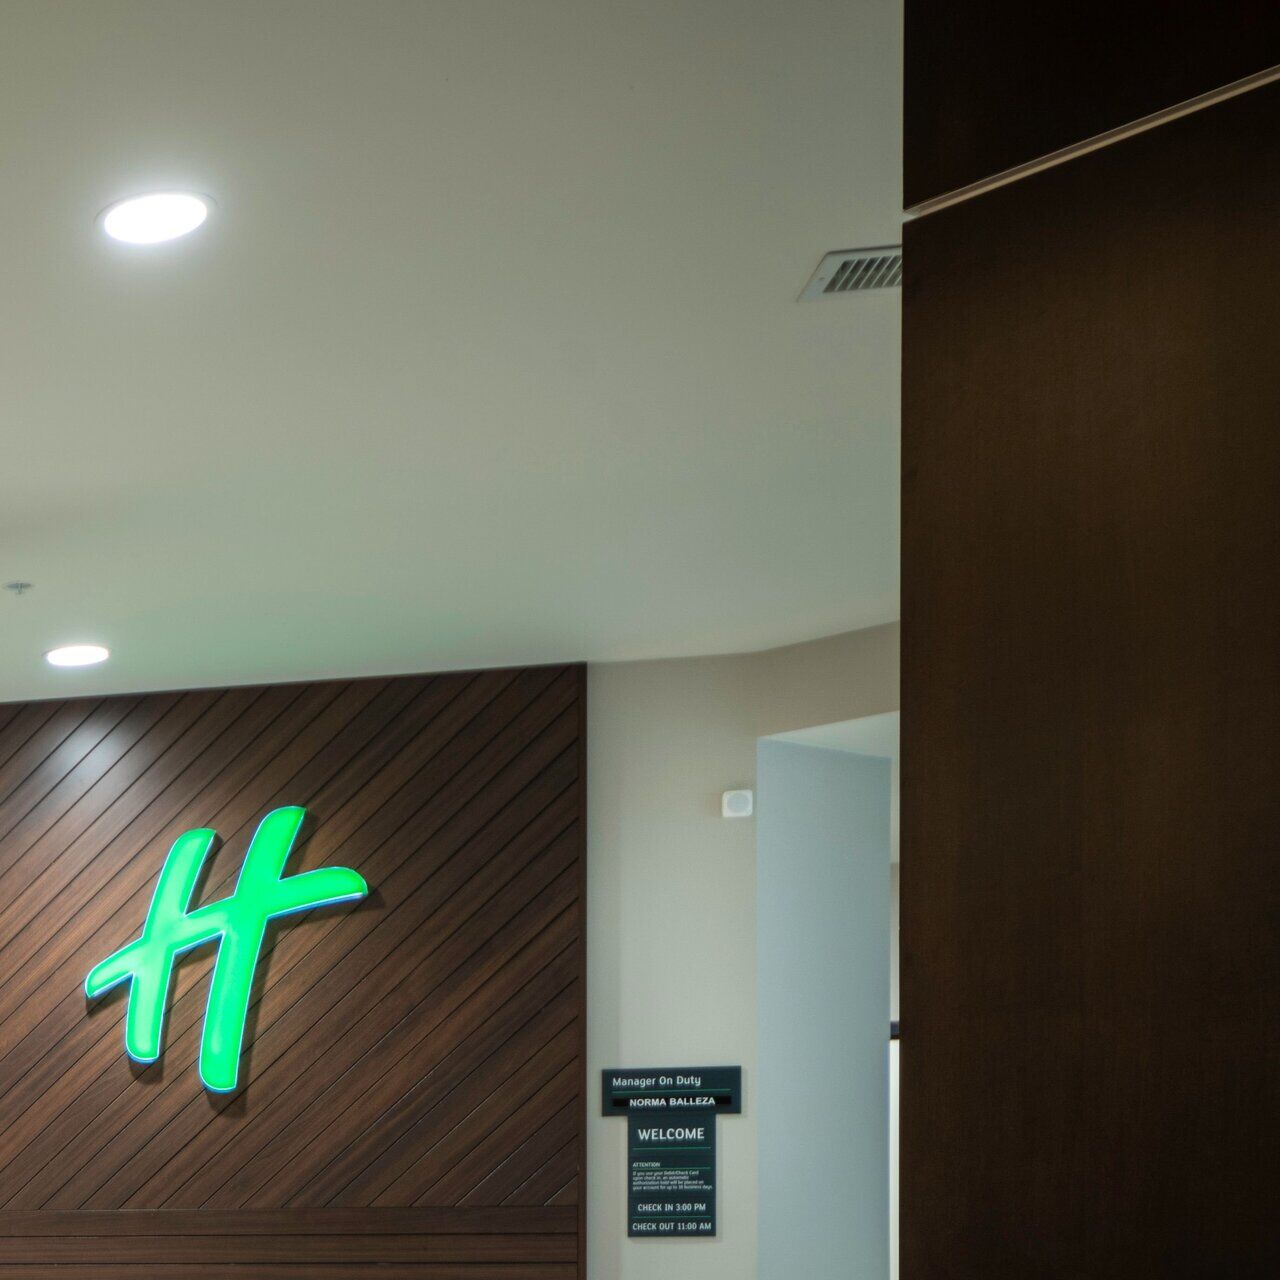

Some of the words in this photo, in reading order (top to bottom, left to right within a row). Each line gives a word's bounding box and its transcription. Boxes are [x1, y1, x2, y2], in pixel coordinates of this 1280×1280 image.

[612, 1077, 656, 1089] Manager
[658, 1076, 673, 1086] On
[676, 1075, 701, 1087] Duty
[629, 1098, 667, 1107] NORMA
[669, 1096, 716, 1106] BALLEZA
[638, 1127, 705, 1141] WELCOME
[637, 1203, 662, 1211] CHECK
[664, 1203, 674, 1211] IN
[675, 1203, 692, 1211] 3:00
[694, 1203, 706, 1211] PM
[632, 1222, 657, 1231] CHECK
[659, 1222, 675, 1230] OUT
[677, 1222, 697, 1230] 11:00
[699, 1222, 712, 1230] AM
